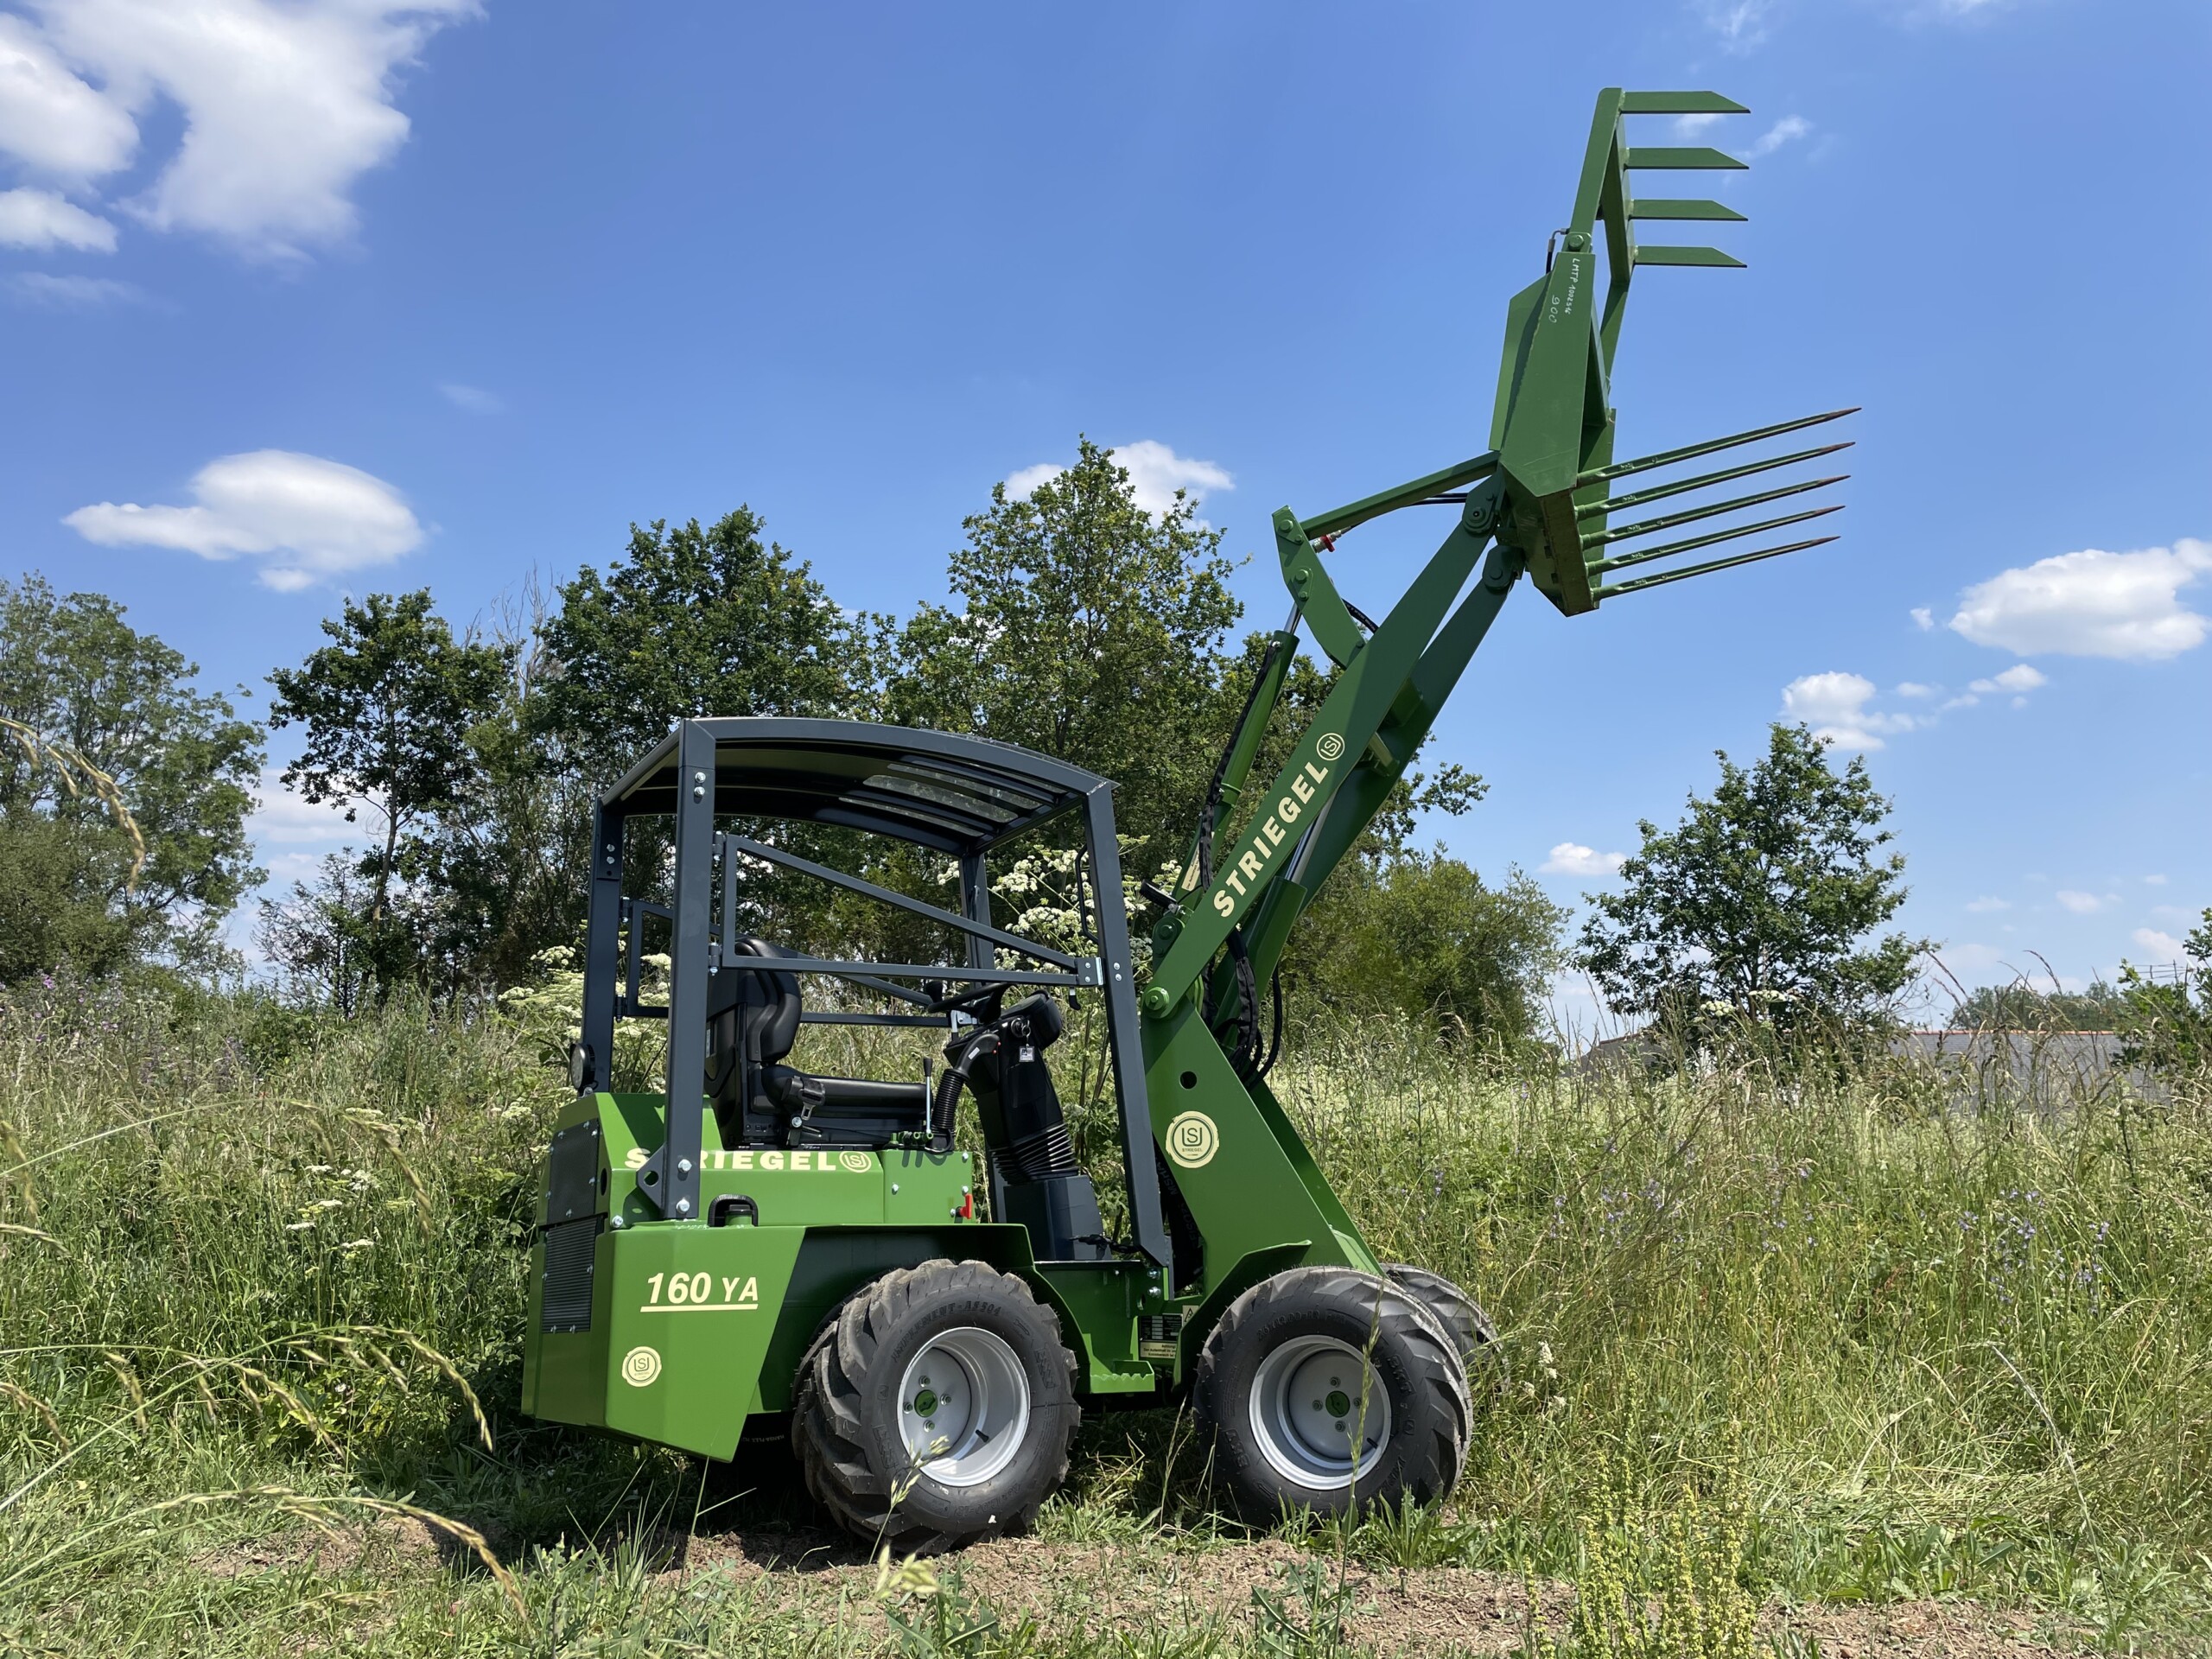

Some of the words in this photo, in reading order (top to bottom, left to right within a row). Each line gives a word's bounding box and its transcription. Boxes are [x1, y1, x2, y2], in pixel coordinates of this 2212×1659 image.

[1570, 257, 1580, 283] LMTP
[1548, 295, 1560, 323] 900
[1213, 761, 1329, 918] STRIEGEL
[625, 1147, 836, 1171] SIEGEL
[647, 1272, 711, 1304] 160
[721, 1277, 759, 1302] YA
